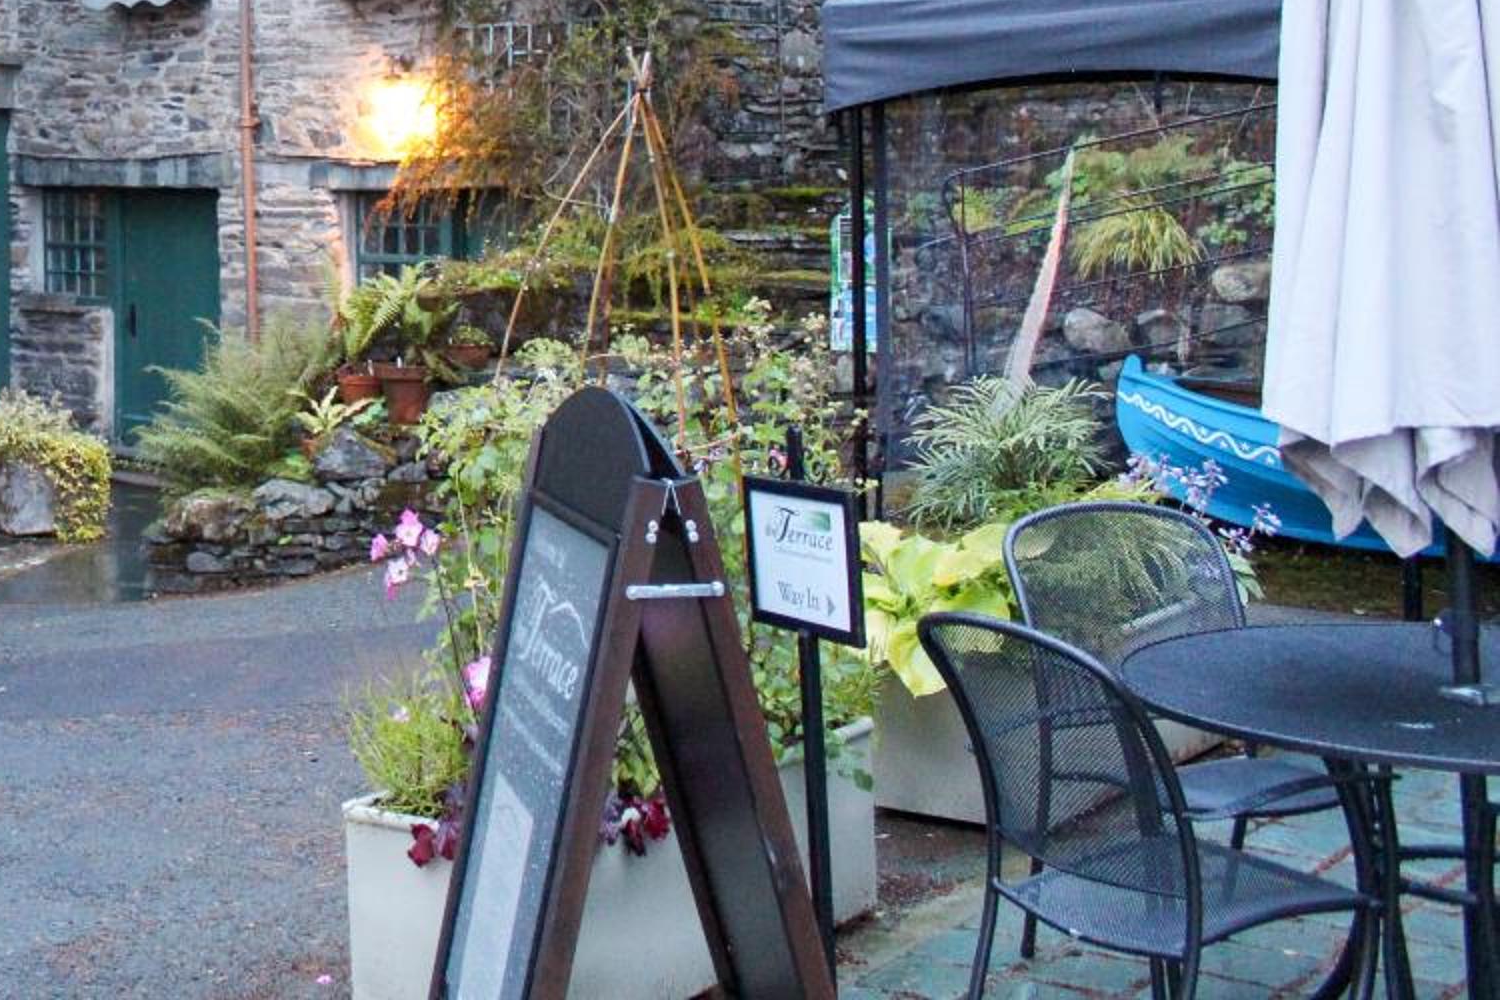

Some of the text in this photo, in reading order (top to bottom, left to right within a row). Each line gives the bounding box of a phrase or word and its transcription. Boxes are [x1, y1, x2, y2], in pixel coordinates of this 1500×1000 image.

[773, 506, 834, 550] Terrace
[777, 580, 821, 610] Way In
[517, 574, 579, 700] Terrace
